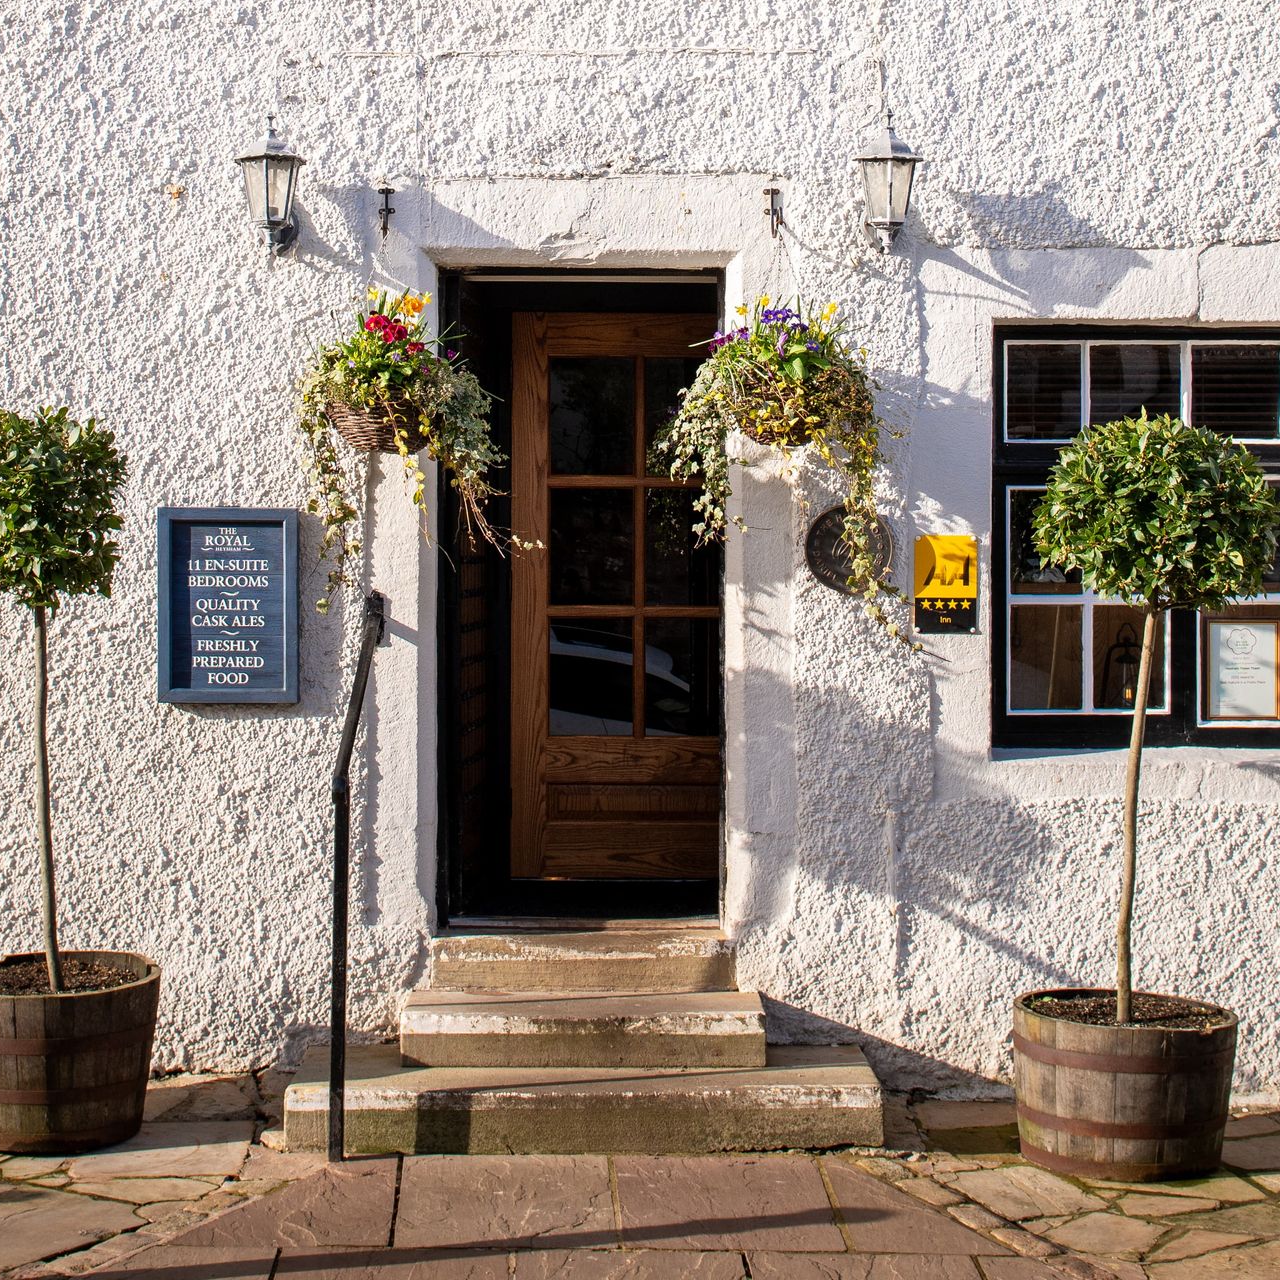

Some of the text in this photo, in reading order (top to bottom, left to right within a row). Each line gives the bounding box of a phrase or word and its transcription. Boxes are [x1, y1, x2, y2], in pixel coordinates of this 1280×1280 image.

[218, 527, 238, 535] THE
[205, 535, 251, 547] ROYAL
[187, 559, 269, 571] 11 EN-SUITE
[187, 575, 269, 588] BEDROOMS
[196, 598, 261, 611] QUALITY
[192, 615, 265, 627] CASK ALES
[939, 616, 952, 624] Inn
[196, 639, 260, 652] FRESHLY
[192, 656, 265, 669] PREPARED
[207, 672, 249, 685] FOOD
